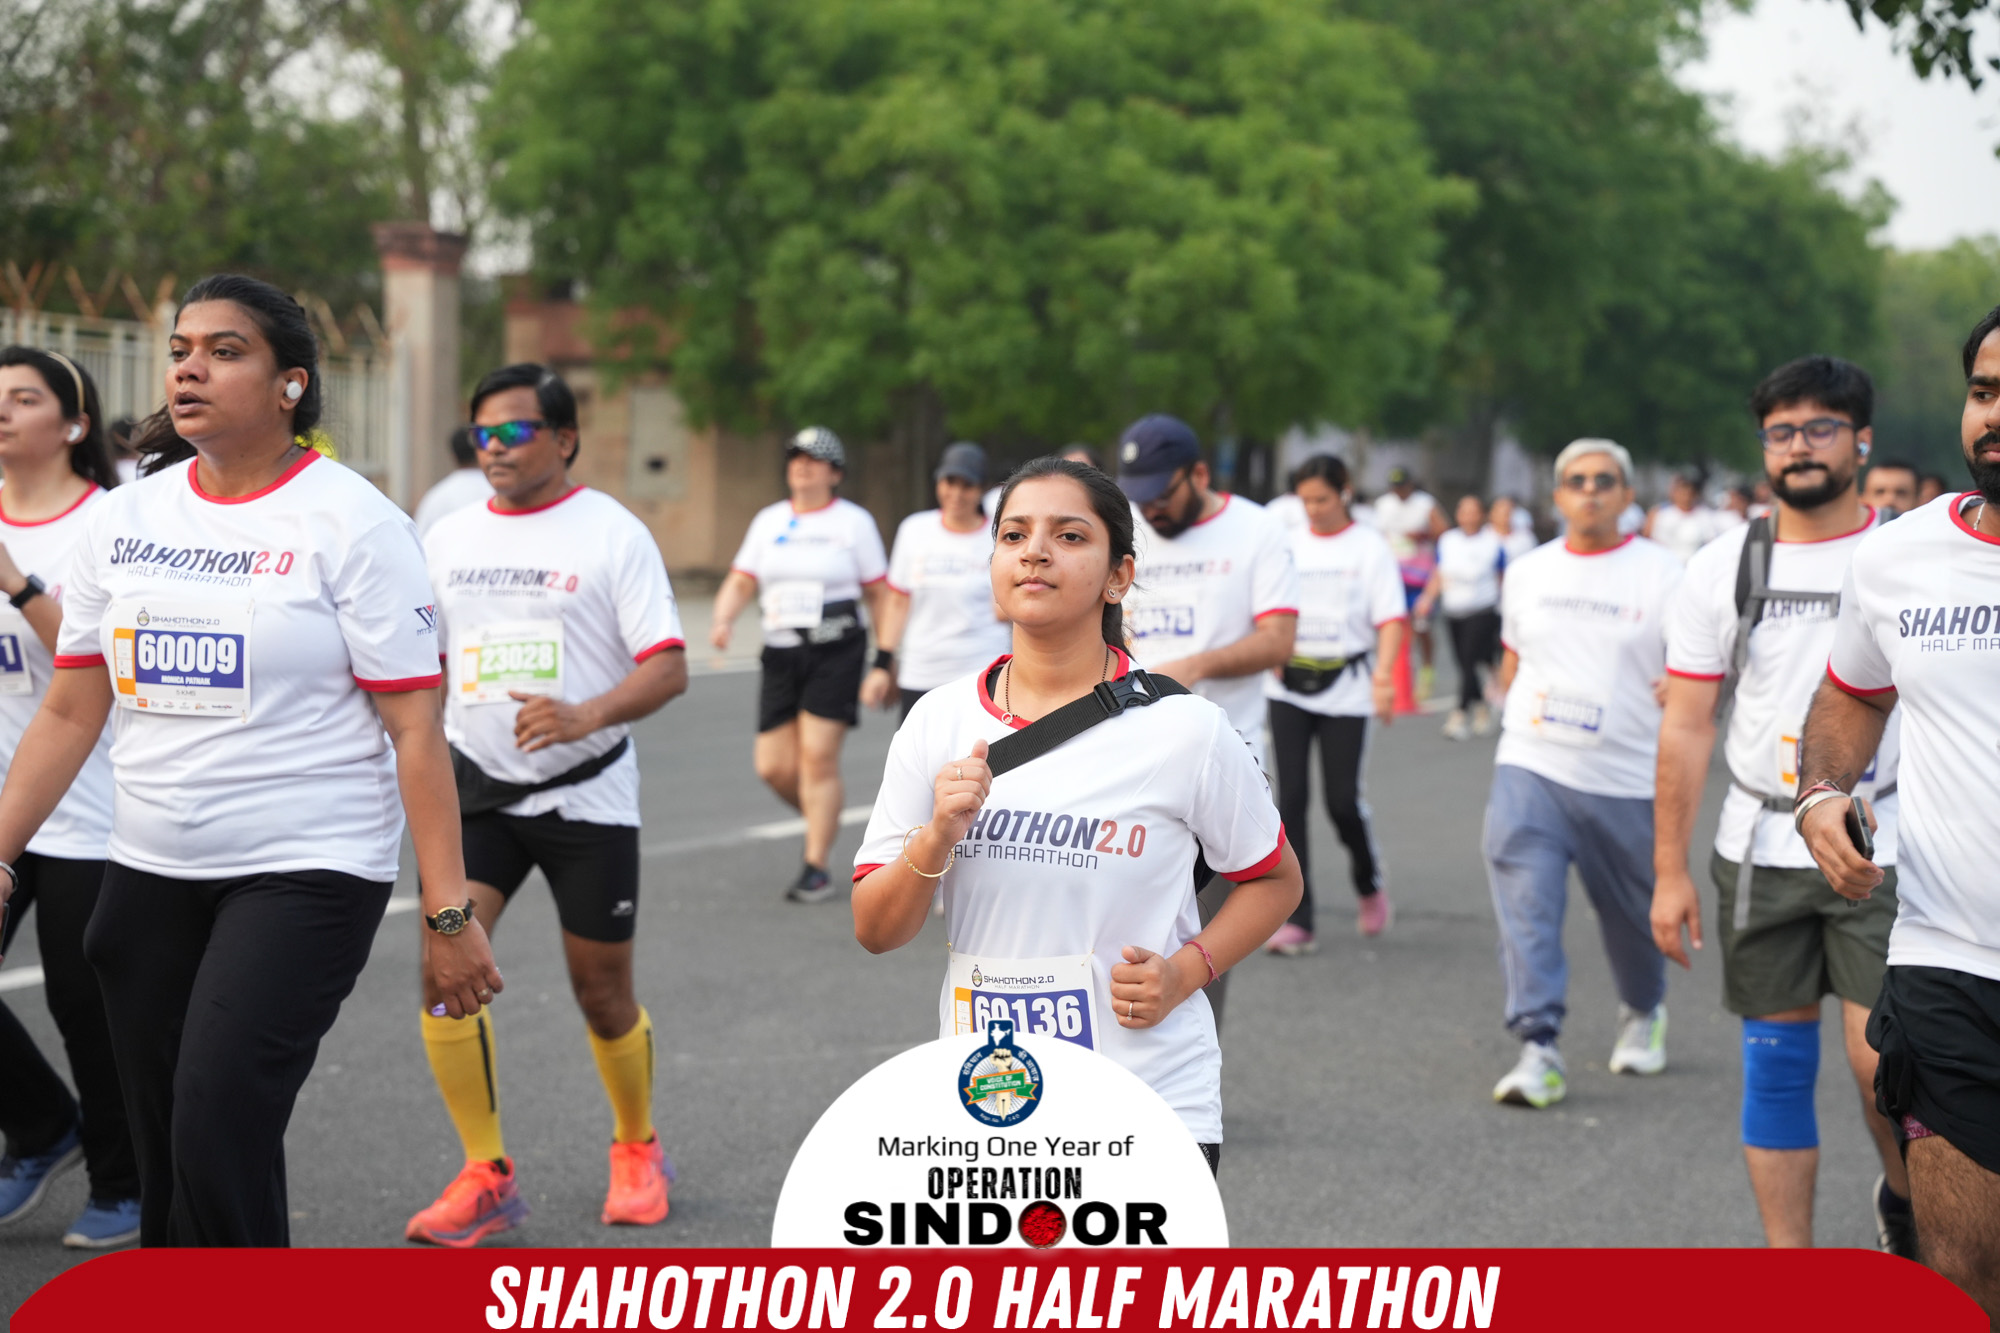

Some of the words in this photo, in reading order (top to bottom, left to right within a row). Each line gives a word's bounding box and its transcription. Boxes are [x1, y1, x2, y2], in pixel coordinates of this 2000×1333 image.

[127, 565, 161, 579] HALF
[164, 569, 252, 587] MARATHON
[138, 633, 237, 674] 60009
[480, 643, 554, 673] 23028
[1921, 638, 1967, 652] HALF
[961, 808, 1146, 858] HOTHON2.0
[948, 844, 983, 858] ALF
[988, 844, 1098, 870] MARATHON
[984, 975, 1036, 985] SHAHOTHON
[1038, 975, 1055, 984] 2.0
